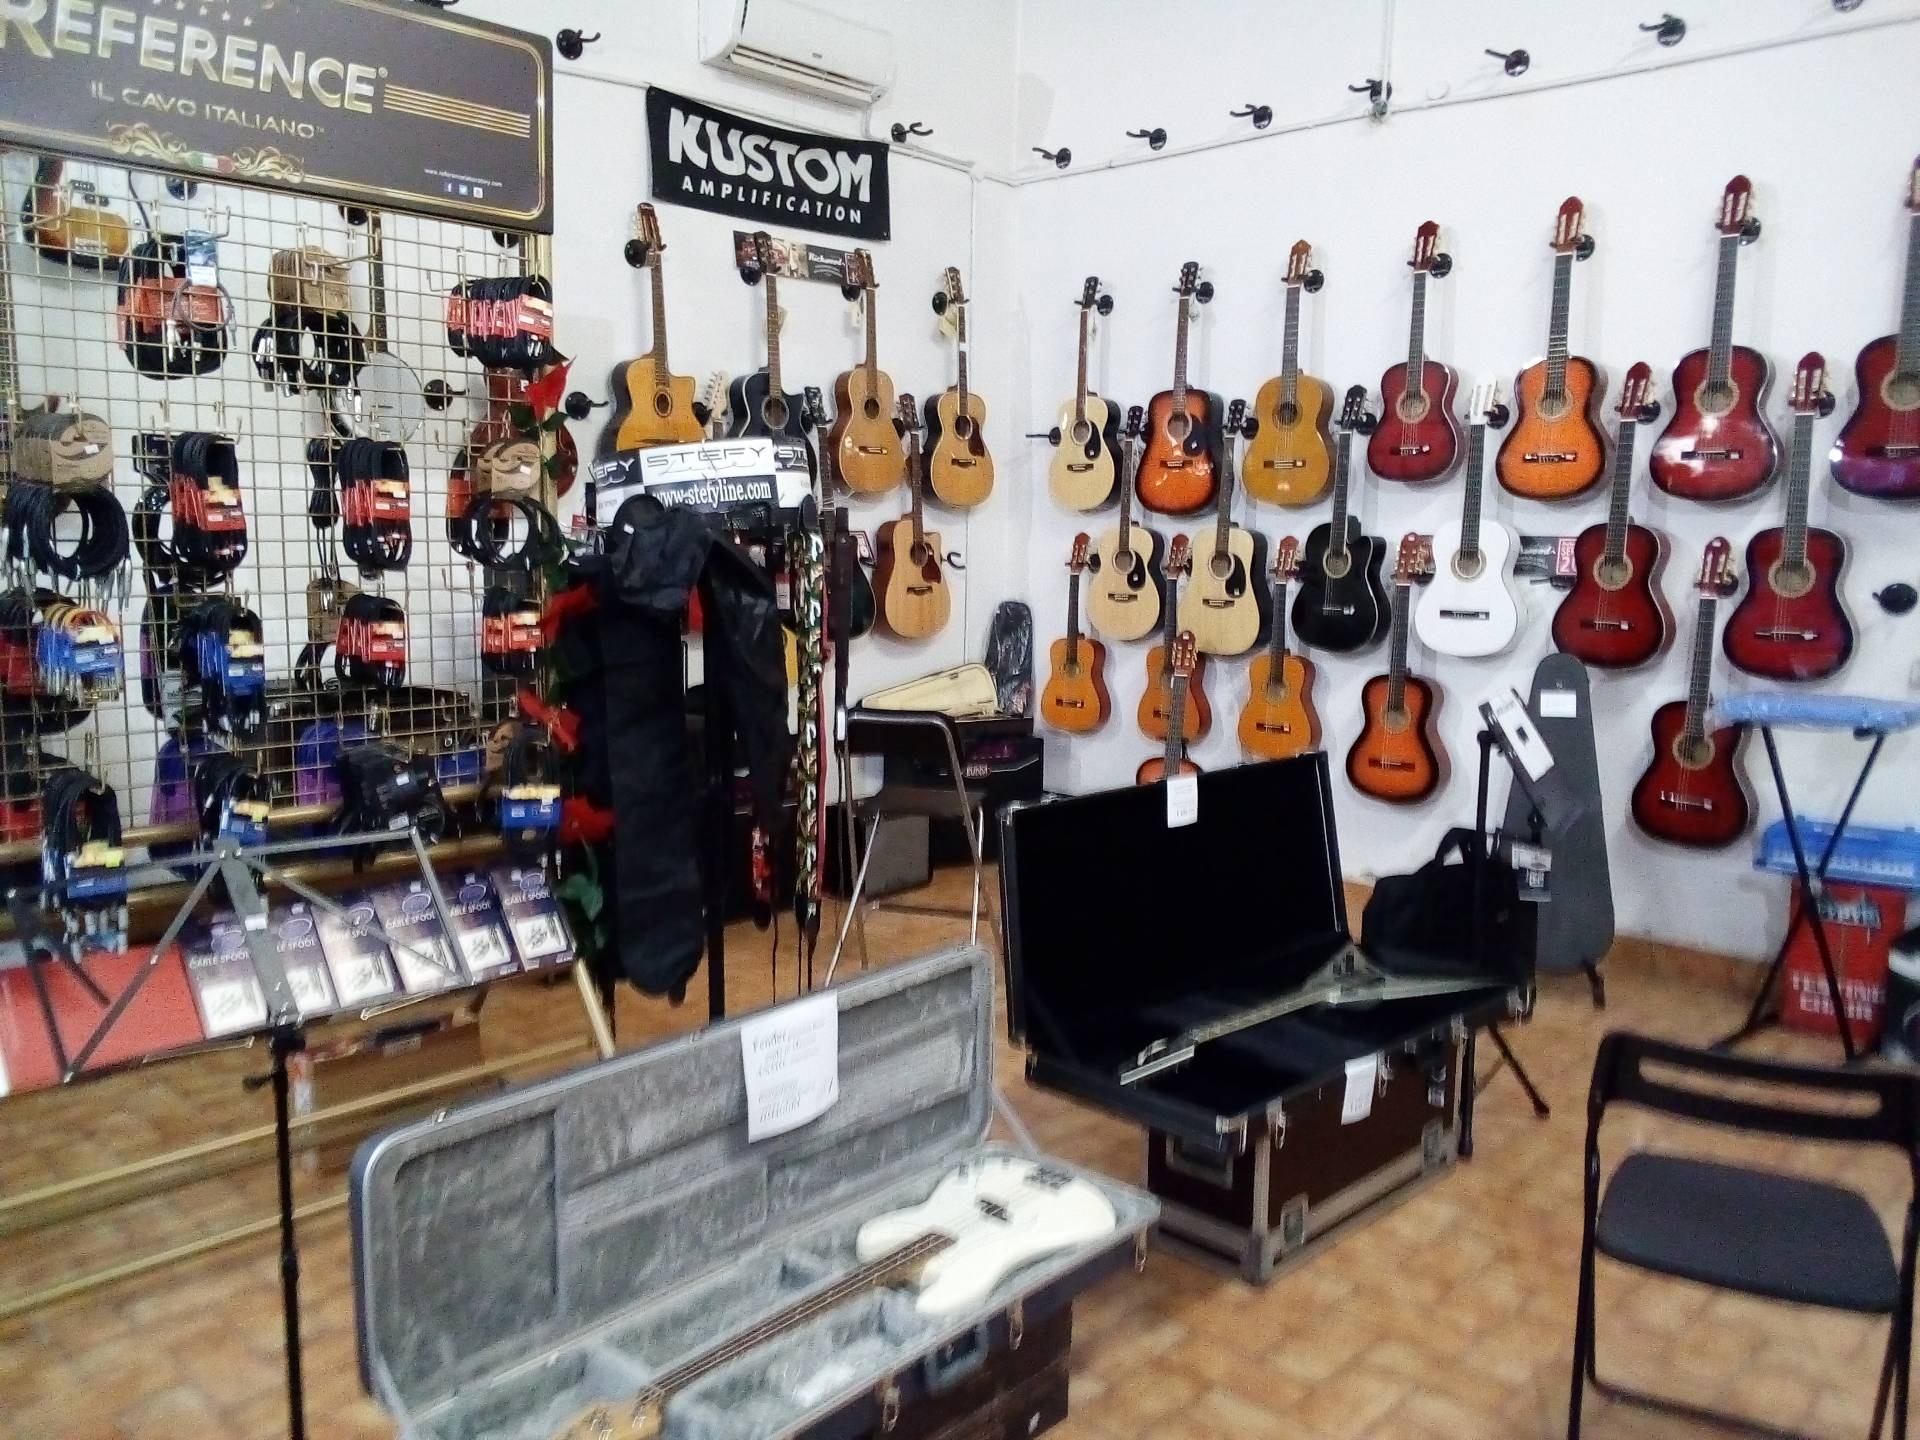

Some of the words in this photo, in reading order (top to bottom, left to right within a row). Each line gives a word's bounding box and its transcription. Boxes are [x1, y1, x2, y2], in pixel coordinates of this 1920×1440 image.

[90, 80, 115, 103] IL
[121, 87, 197, 117] CAVO
[668, 107, 873, 203] KUSTOM
[681, 175, 862, 225] AMPLIFICATION
[646, 446, 767, 468] STEFY
[527, 890, 551, 902] SPOOL
